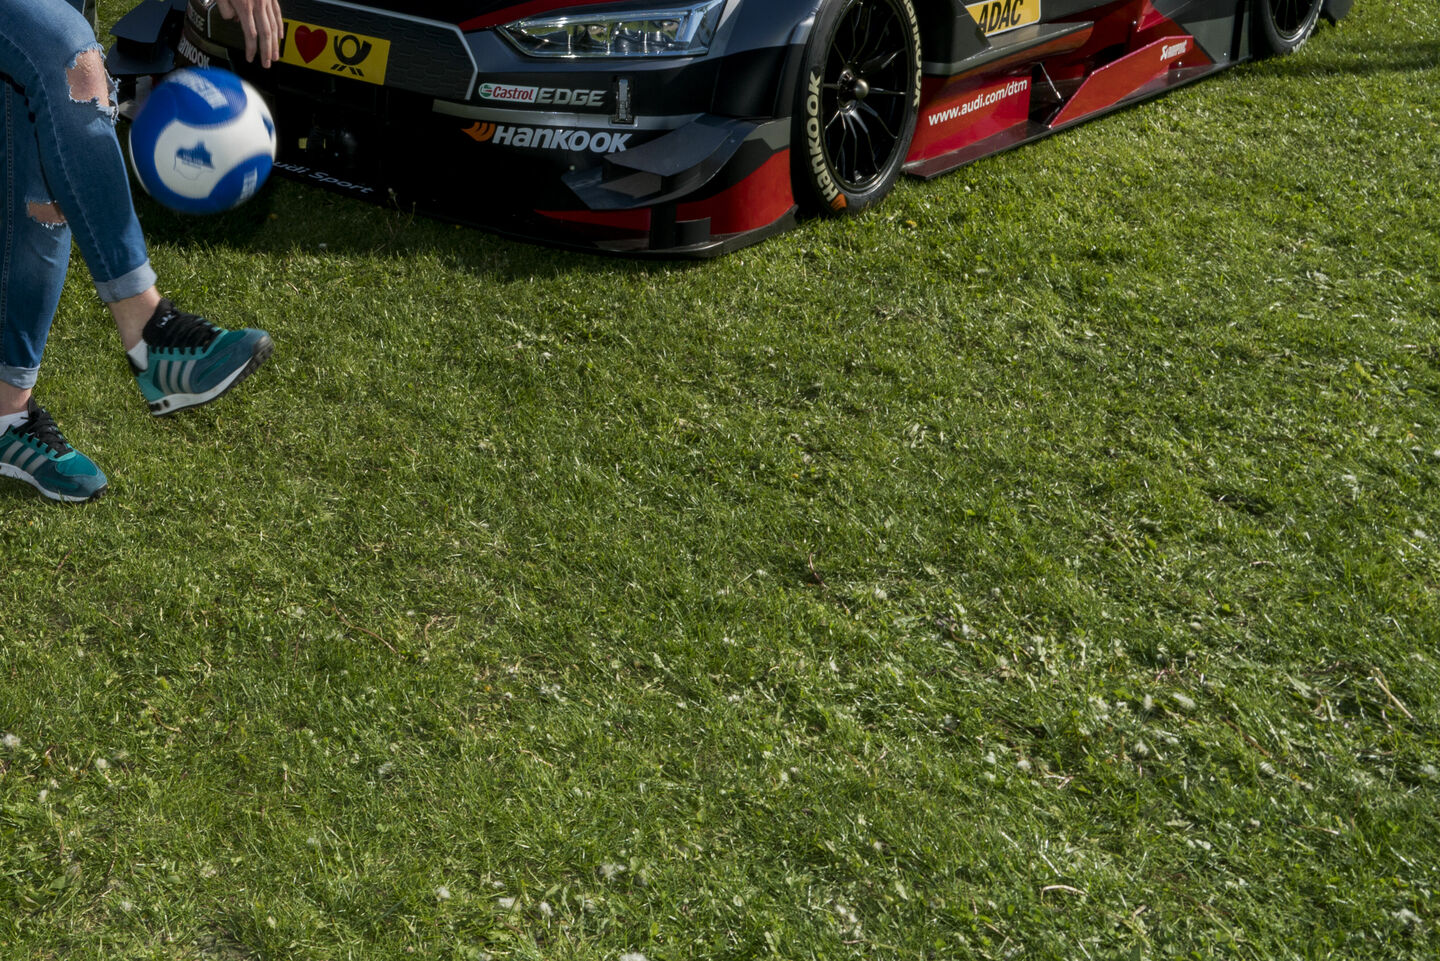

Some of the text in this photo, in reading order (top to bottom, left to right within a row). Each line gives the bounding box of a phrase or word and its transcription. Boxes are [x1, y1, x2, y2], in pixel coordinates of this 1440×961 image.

[492, 85, 608, 107] Castrol EDGE
[928, 78, 1028, 127] www.audi.com/dtm
[273, 161, 374, 194] udi Sport
